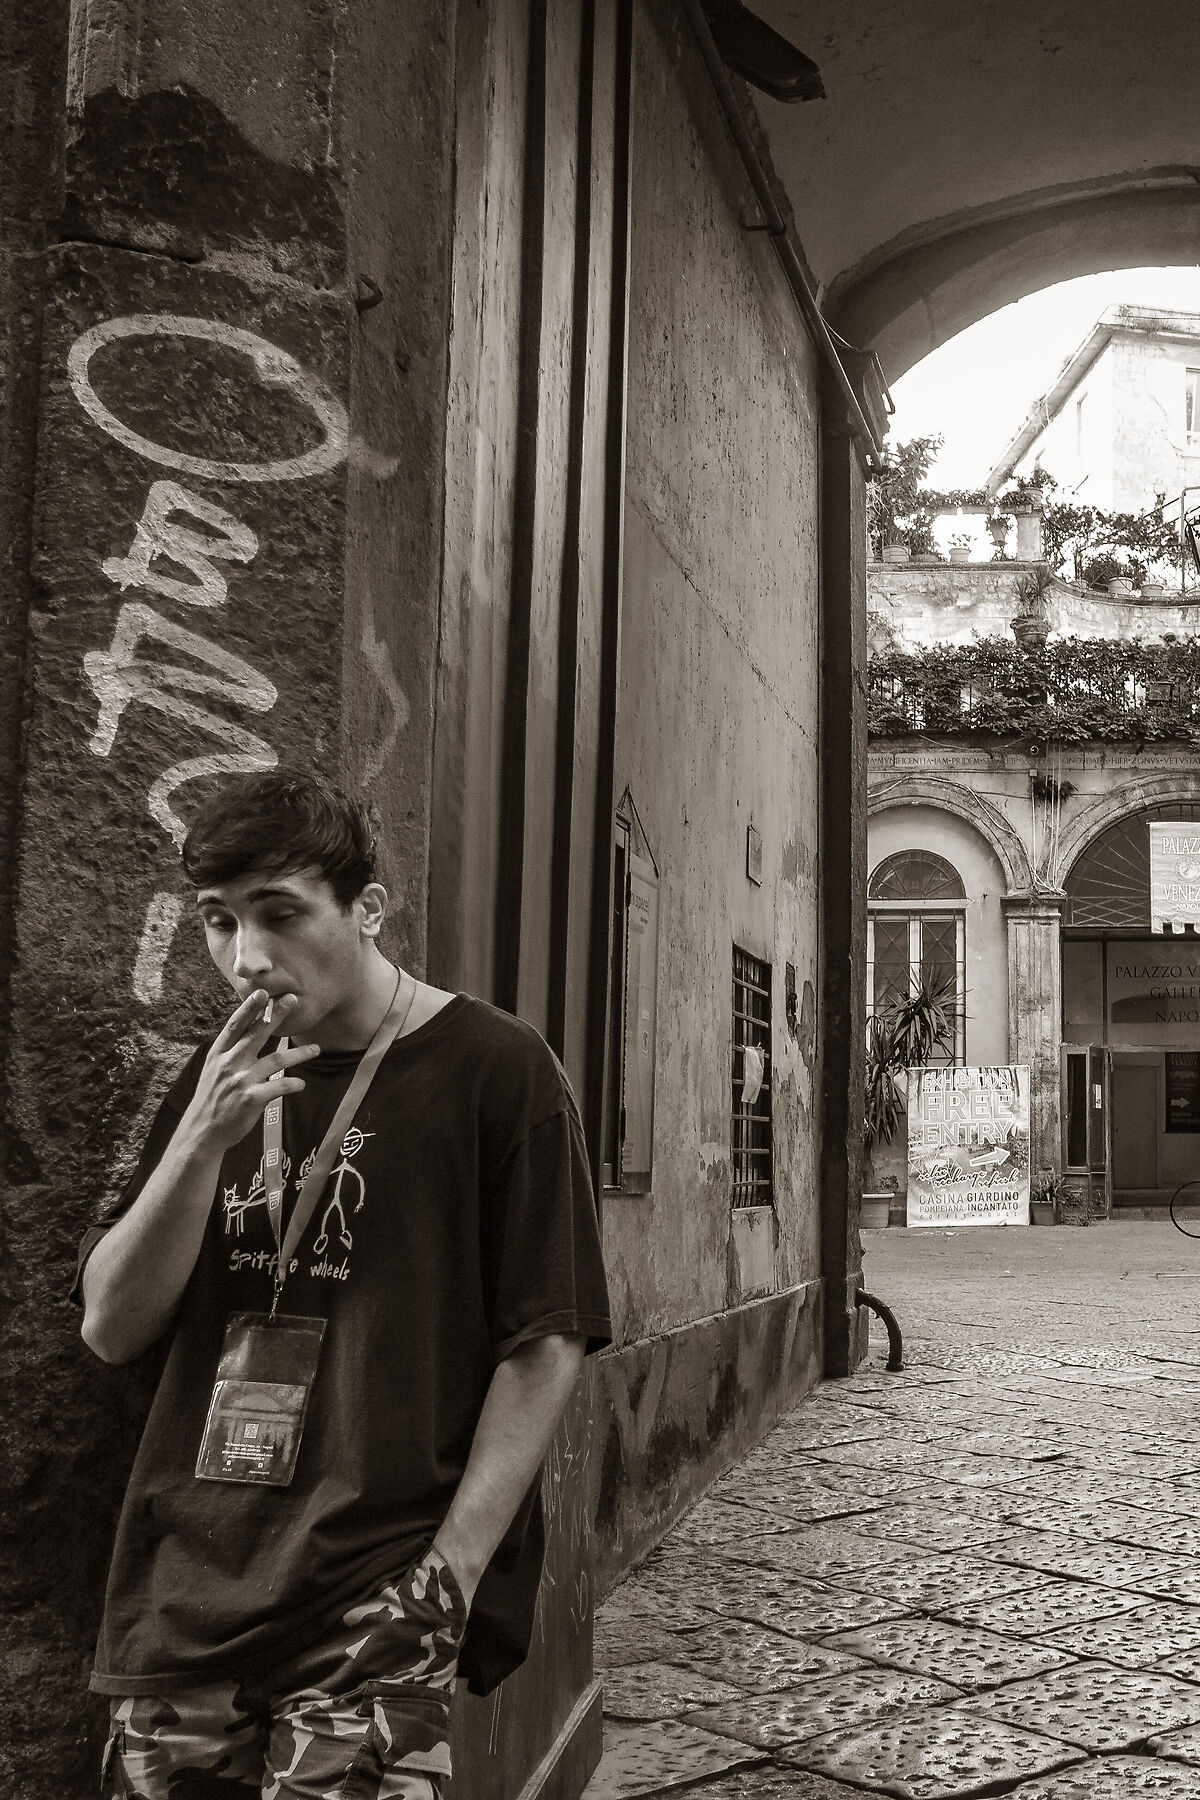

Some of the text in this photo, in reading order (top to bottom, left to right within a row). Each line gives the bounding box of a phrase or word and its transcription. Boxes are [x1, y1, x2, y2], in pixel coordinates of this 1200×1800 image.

[1115, 966, 1182, 978] PALAZZO
[922, 1073, 1012, 1089] EXHIBITION
[923, 1090, 1014, 1121] FREE
[923, 1121, 1013, 1145] ENTRY
[919, 1191, 1019, 1205] CASINA GIARDINO
[967, 1202, 1019, 1212] INCANTATO
[310, 1253, 350, 1281] wheels
